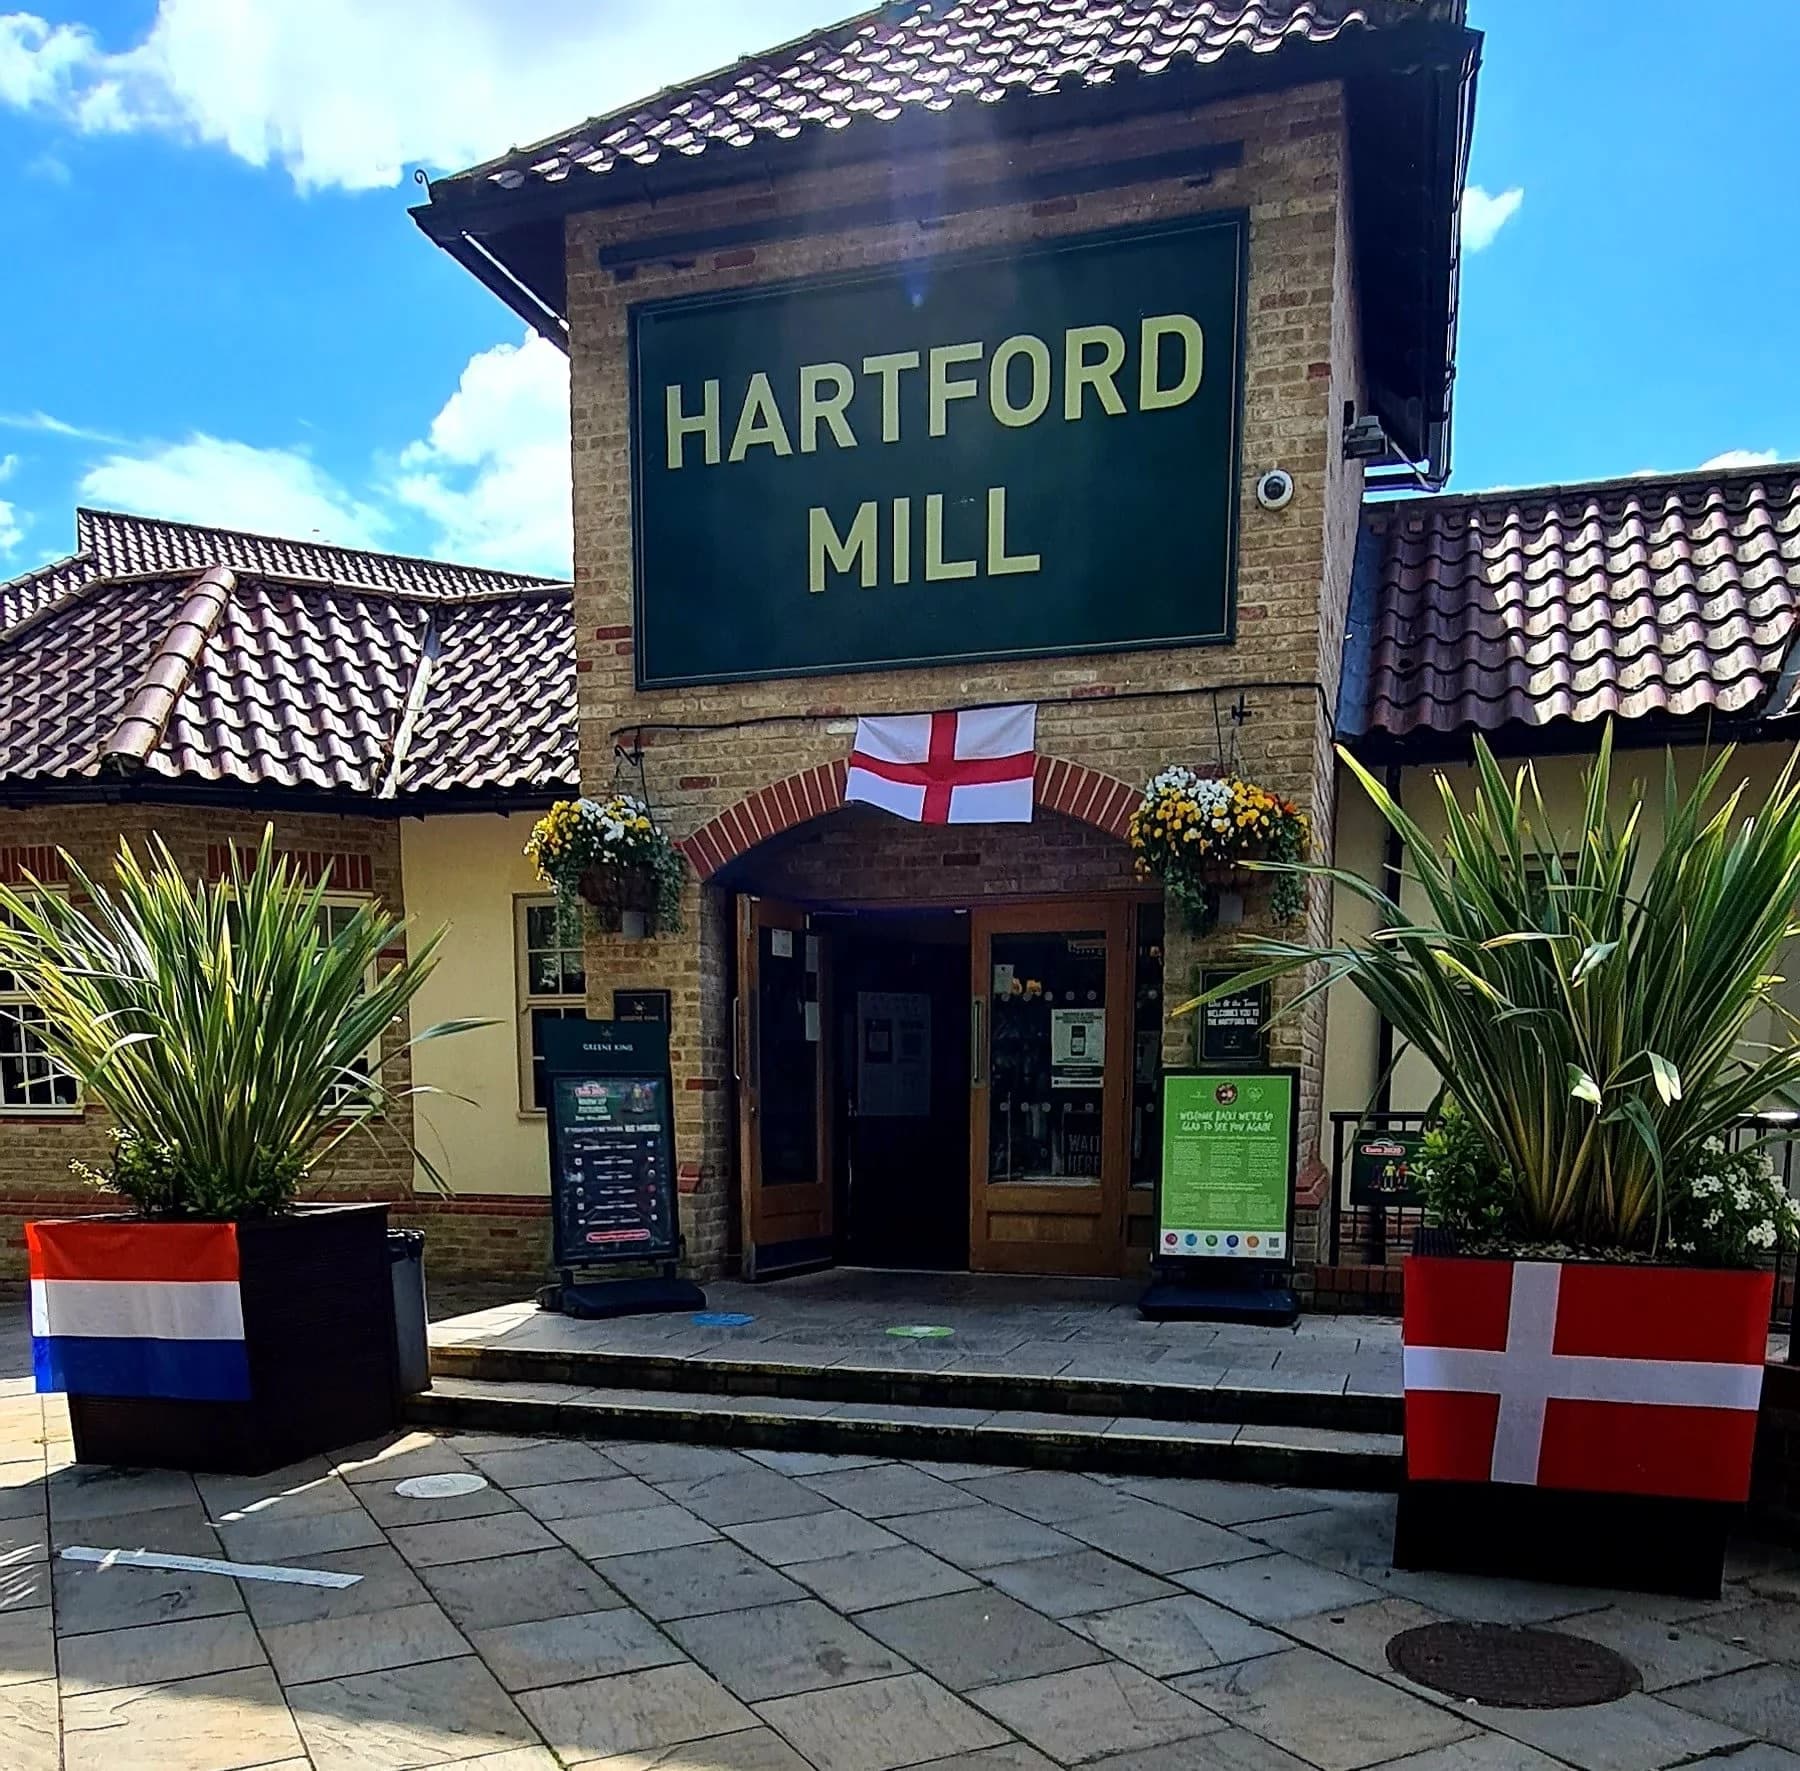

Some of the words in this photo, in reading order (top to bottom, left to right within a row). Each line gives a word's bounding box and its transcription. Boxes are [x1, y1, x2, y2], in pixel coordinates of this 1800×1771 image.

[666, 314, 1203, 469] HARTFORD
[808, 487, 1040, 593] MILL
[1069, 1134, 1100, 1152] WAIT
[1201, 1121, 1213, 1131] TO
